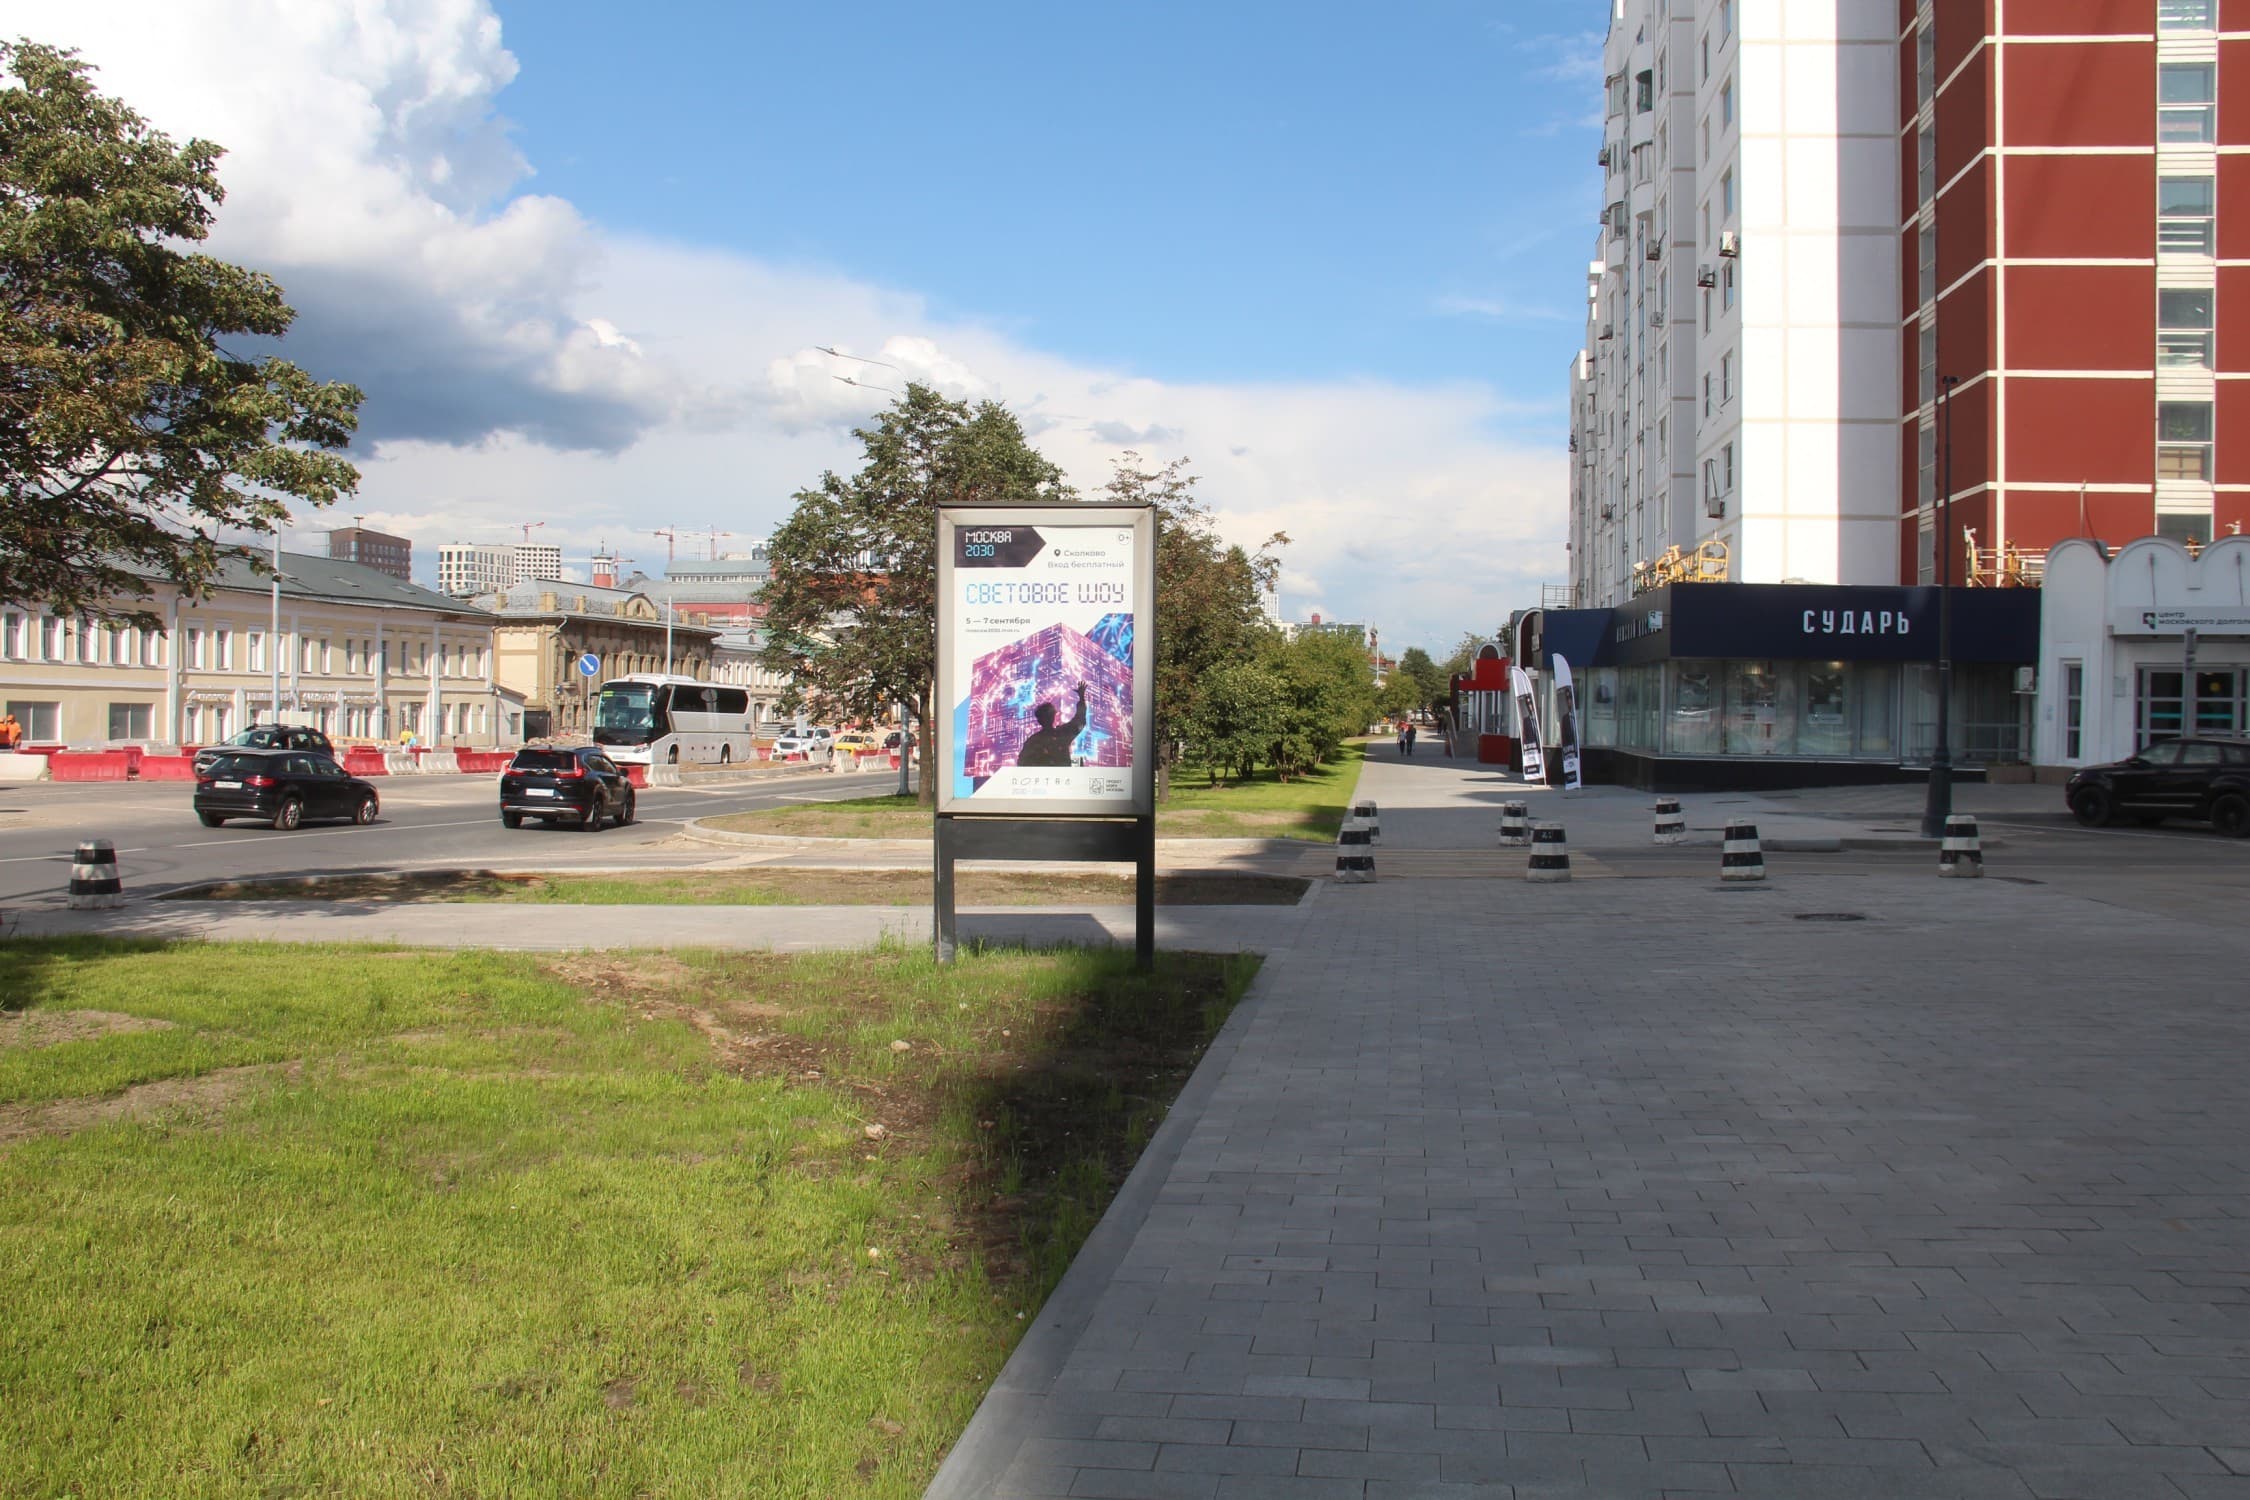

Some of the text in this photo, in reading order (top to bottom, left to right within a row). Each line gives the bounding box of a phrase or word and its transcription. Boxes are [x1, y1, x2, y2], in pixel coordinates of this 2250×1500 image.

[965, 531, 1012, 543] МОСКВА
[965, 544, 995, 557] 2030
[966, 583, 1125, 604] СВЕТОВОЕ ШОУ
[966, 617, 972, 625] 5
[1803, 610, 1910, 634] СУДАРЬ
